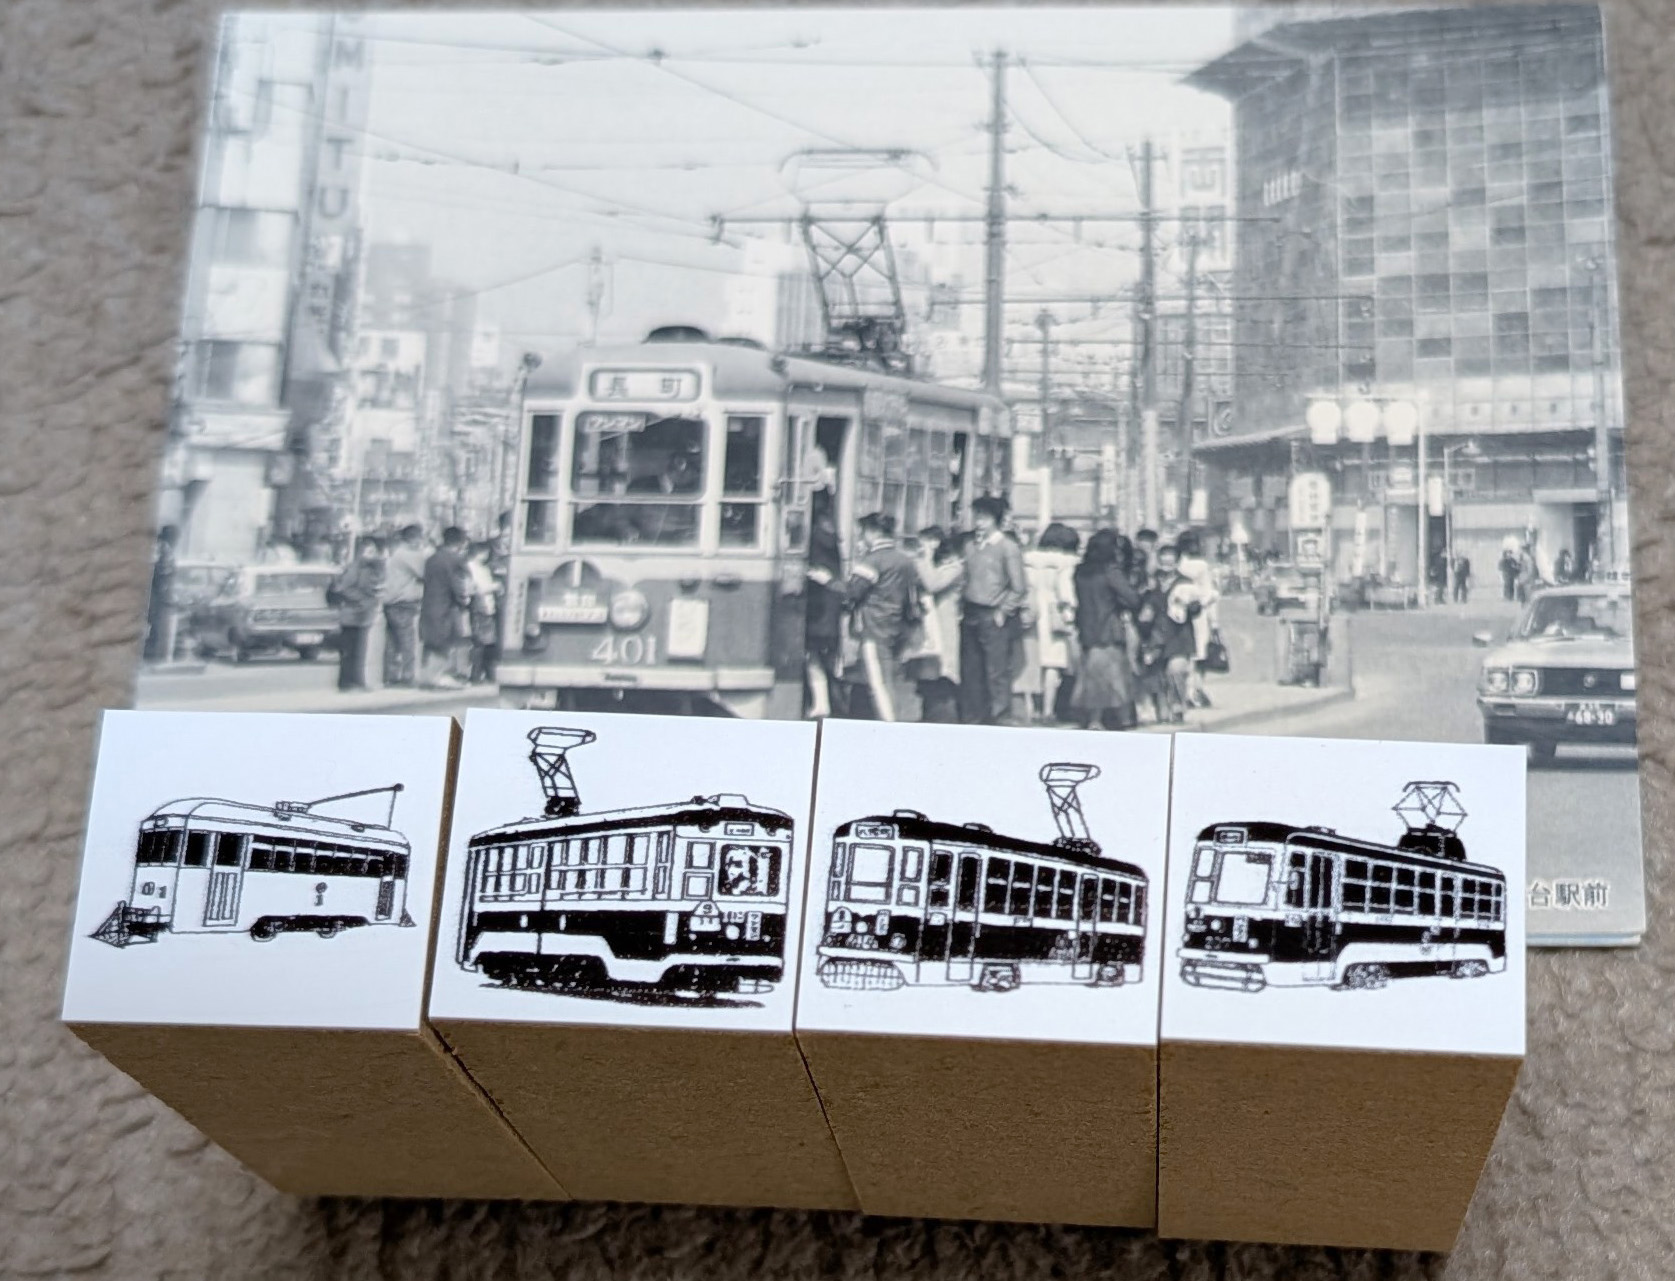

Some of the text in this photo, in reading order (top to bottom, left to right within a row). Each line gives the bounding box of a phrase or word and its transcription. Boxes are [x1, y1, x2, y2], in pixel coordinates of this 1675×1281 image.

[590, 635, 657, 666] 401
[1530, 881, 1609, 907] 台駅前
